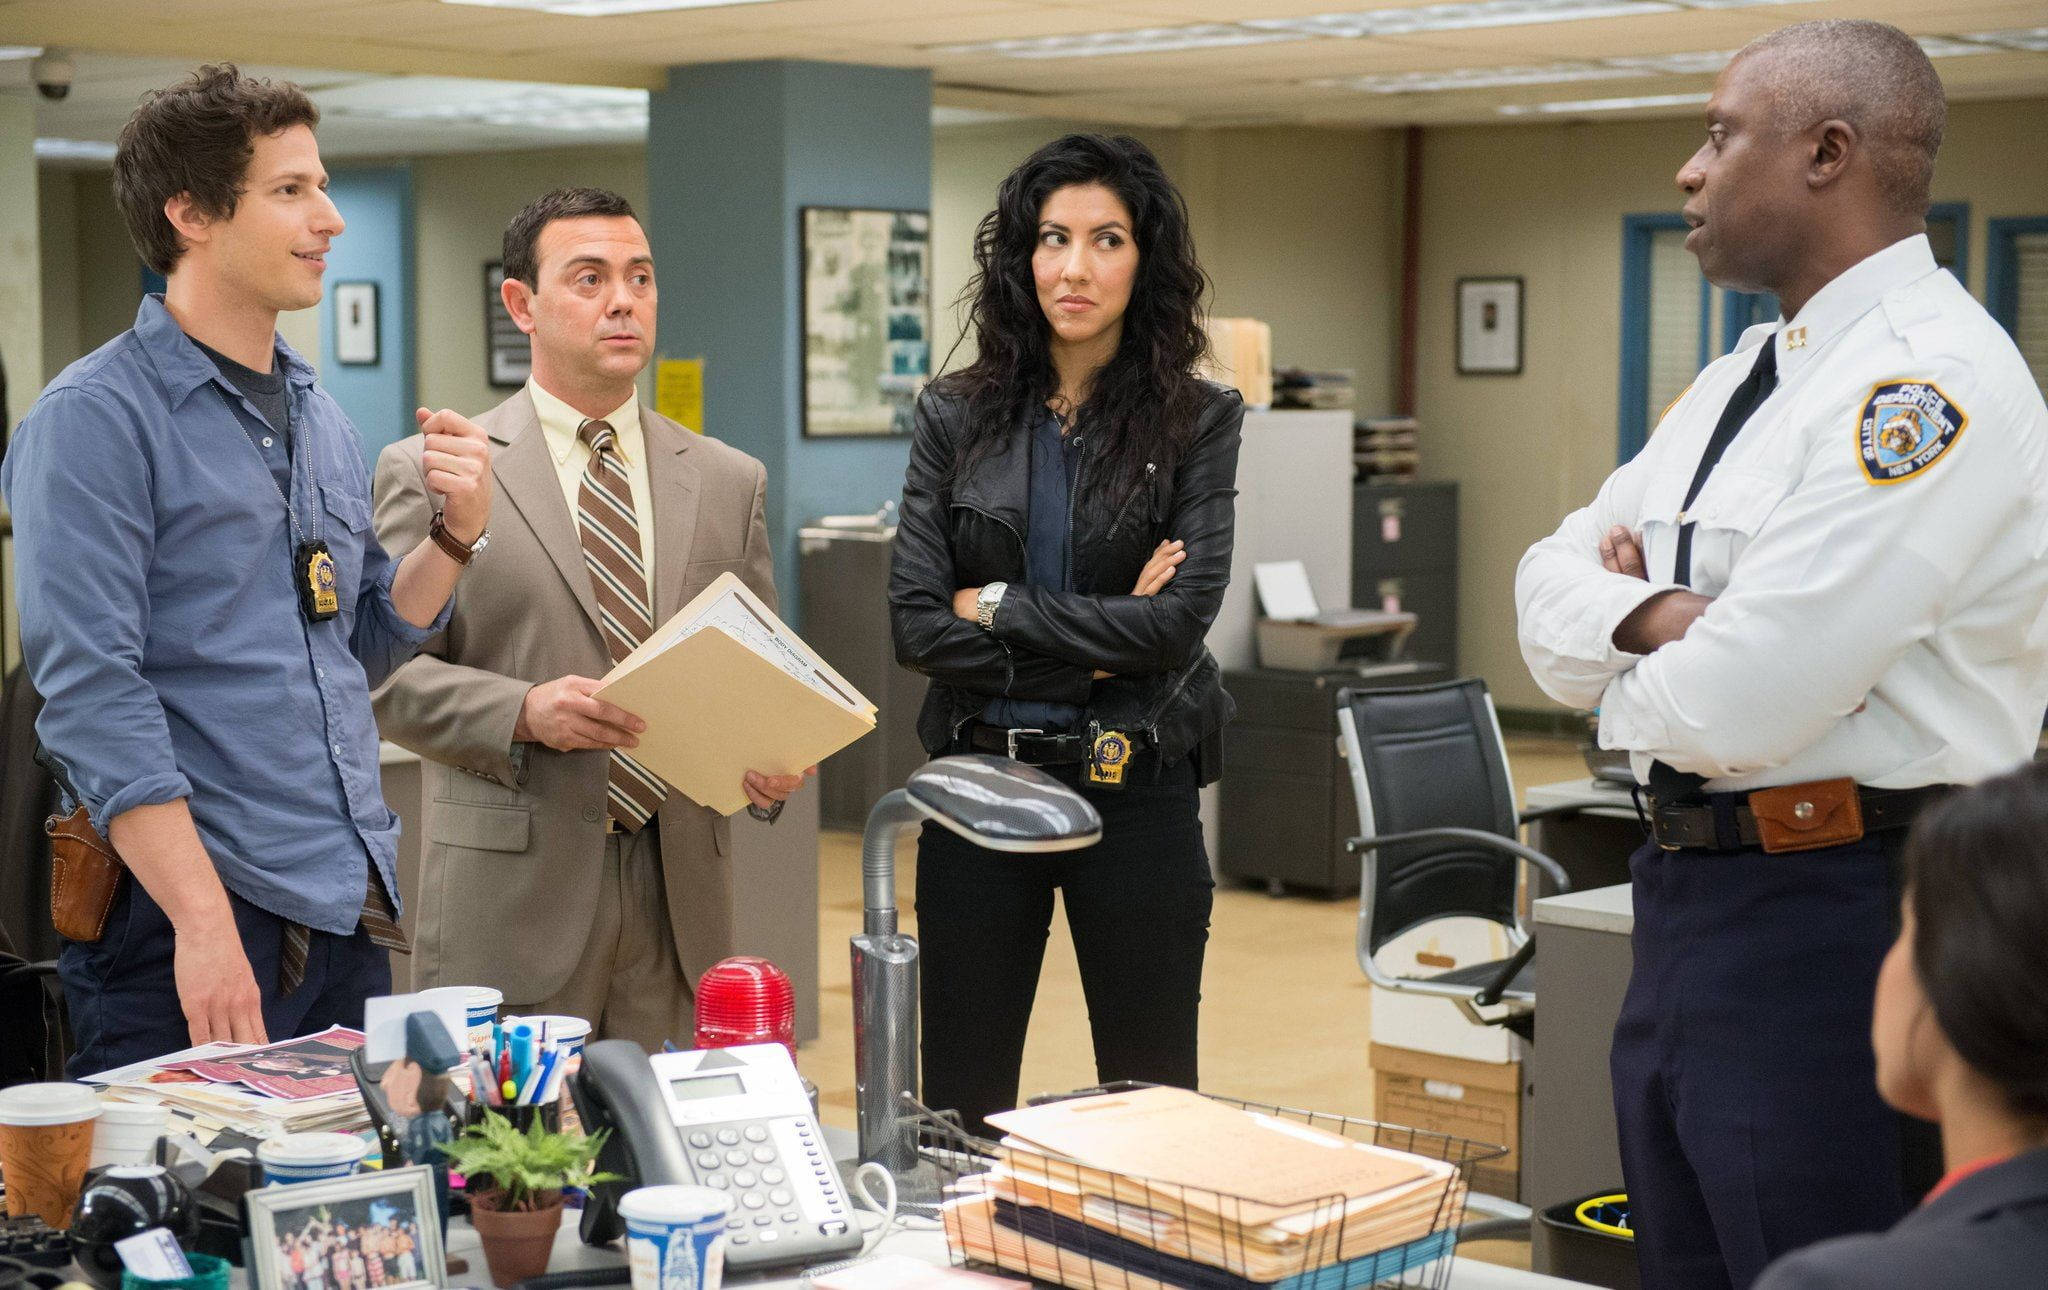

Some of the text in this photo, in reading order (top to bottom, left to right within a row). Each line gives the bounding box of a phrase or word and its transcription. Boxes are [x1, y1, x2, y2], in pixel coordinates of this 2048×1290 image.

[1873, 394, 1955, 435] DEPARTMENT
[1899, 384, 1947, 411] POLICE
[1861, 418, 1875, 461] CITY OF
[1889, 440, 1945, 477] NEW YORK
[774, 637, 808, 667] BODY DIAGRAM
